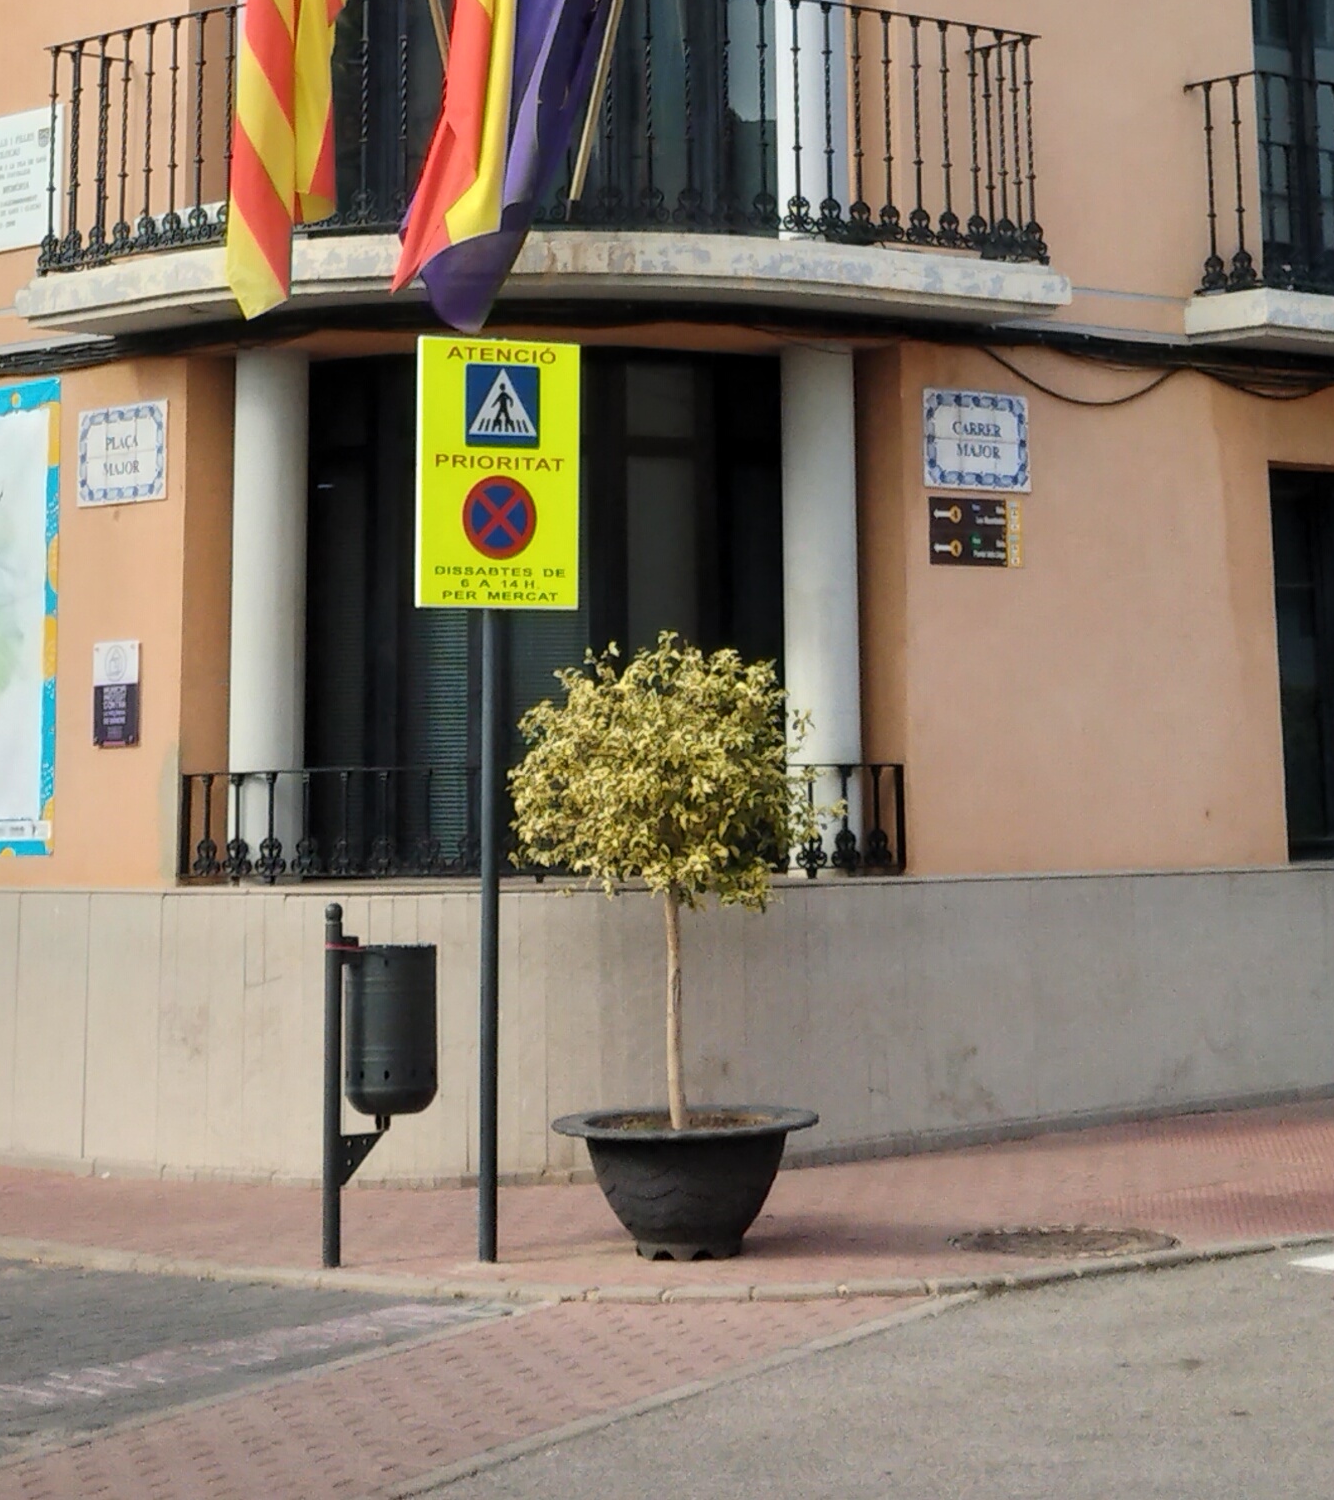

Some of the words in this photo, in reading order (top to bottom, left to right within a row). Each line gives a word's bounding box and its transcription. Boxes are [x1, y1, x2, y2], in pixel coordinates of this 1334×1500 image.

[447, 346, 557, 364] ATENCIÓ
[952, 421, 1002, 438] CARRER
[105, 435, 139, 451] PLAÇA
[956, 443, 1001, 460] MAJOR
[103, 460, 140, 476] MAJOR
[435, 454, 565, 472] PRIORITAT
[434, 565, 533, 578] DISSABTES
[543, 567, 566, 578] DE
[461, 578, 469, 588] 6
[479, 579, 491, 589] A
[442, 590, 477, 600] PER
[488, 590, 559, 602] MERCAT
